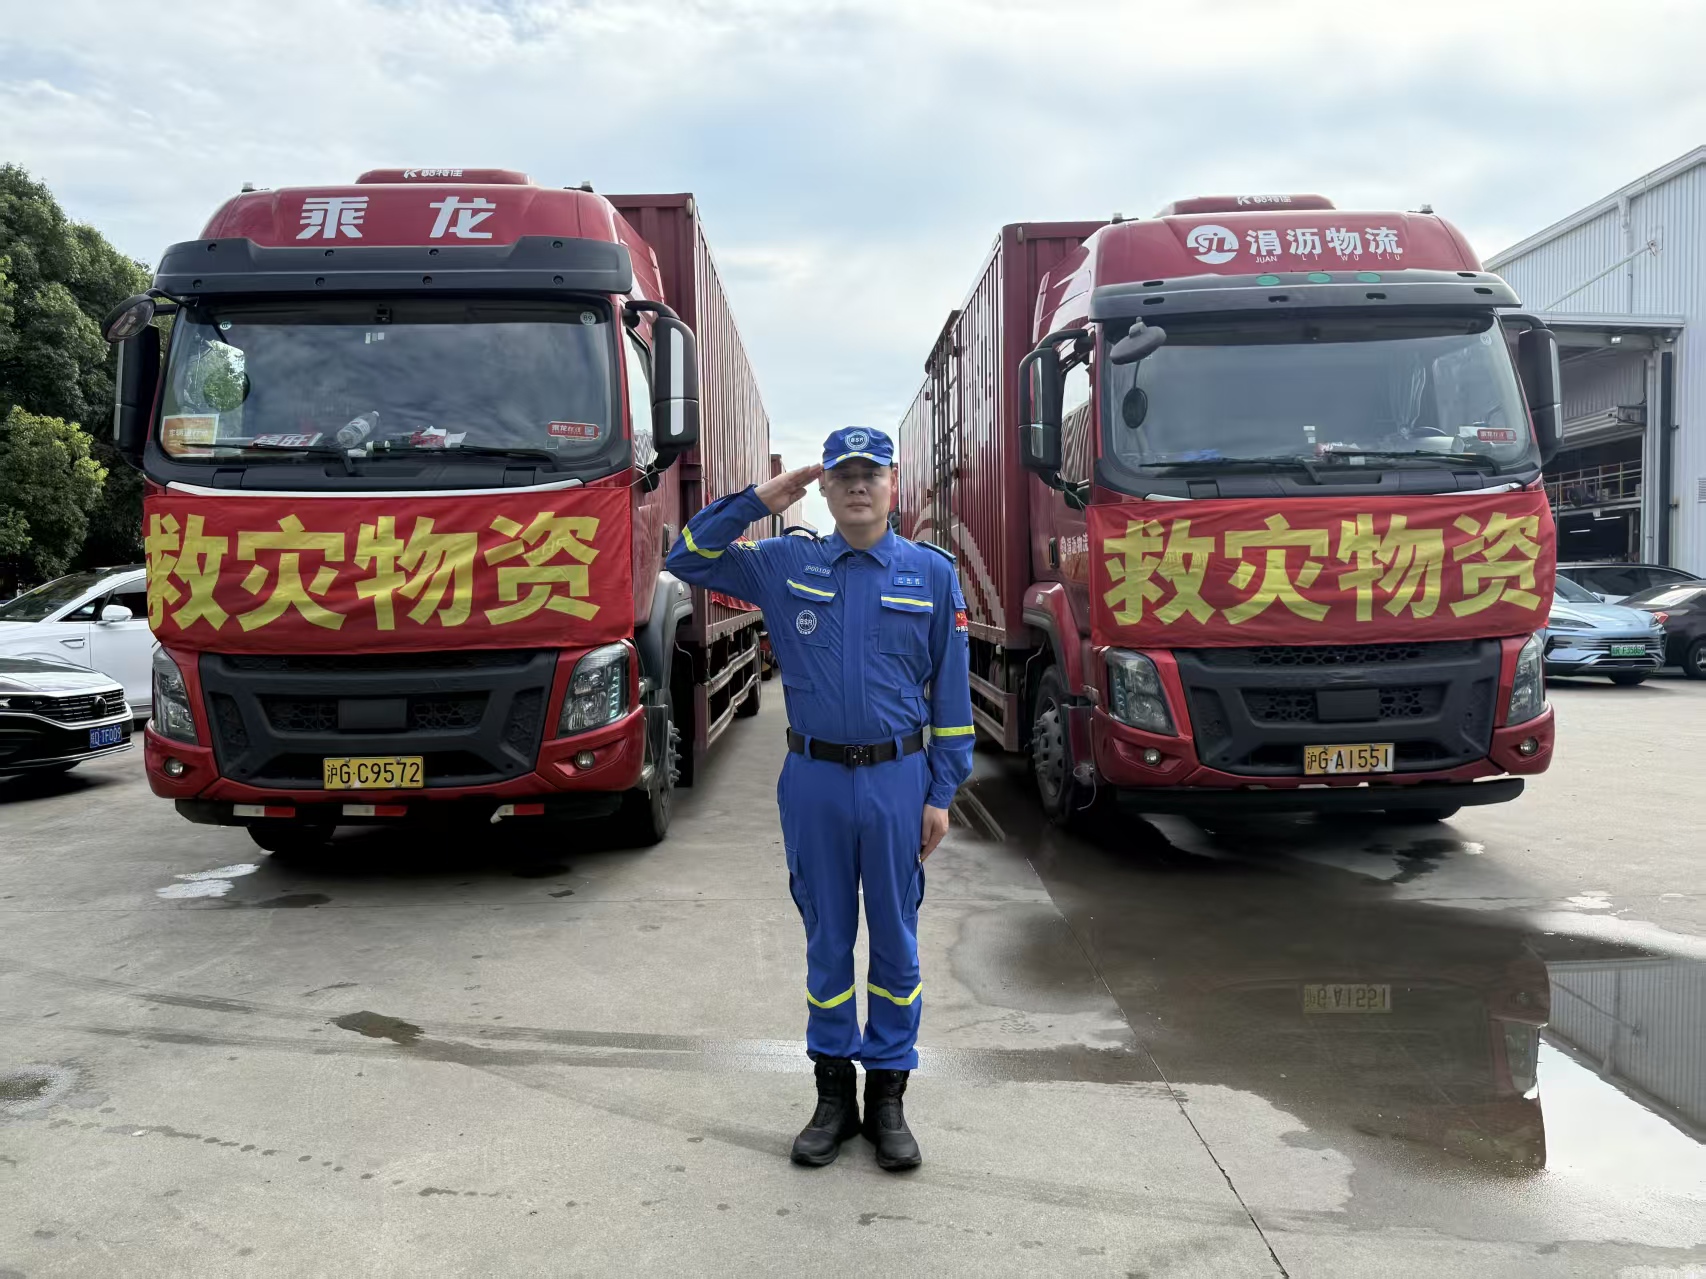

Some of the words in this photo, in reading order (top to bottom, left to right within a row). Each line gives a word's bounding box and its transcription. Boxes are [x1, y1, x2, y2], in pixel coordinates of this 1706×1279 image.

[295, 195, 497, 239] 乘龙
[1246, 226, 1404, 257] 涓沥物流
[1255, 255, 1278, 264] JUAN
[145, 511, 601, 632] 救灾物资
[1103, 512, 1542, 625] 救灾物资
[326, 762, 420, 784] 沪G·C9572
[1307, 748, 1388, 770] 沪G·A1551
